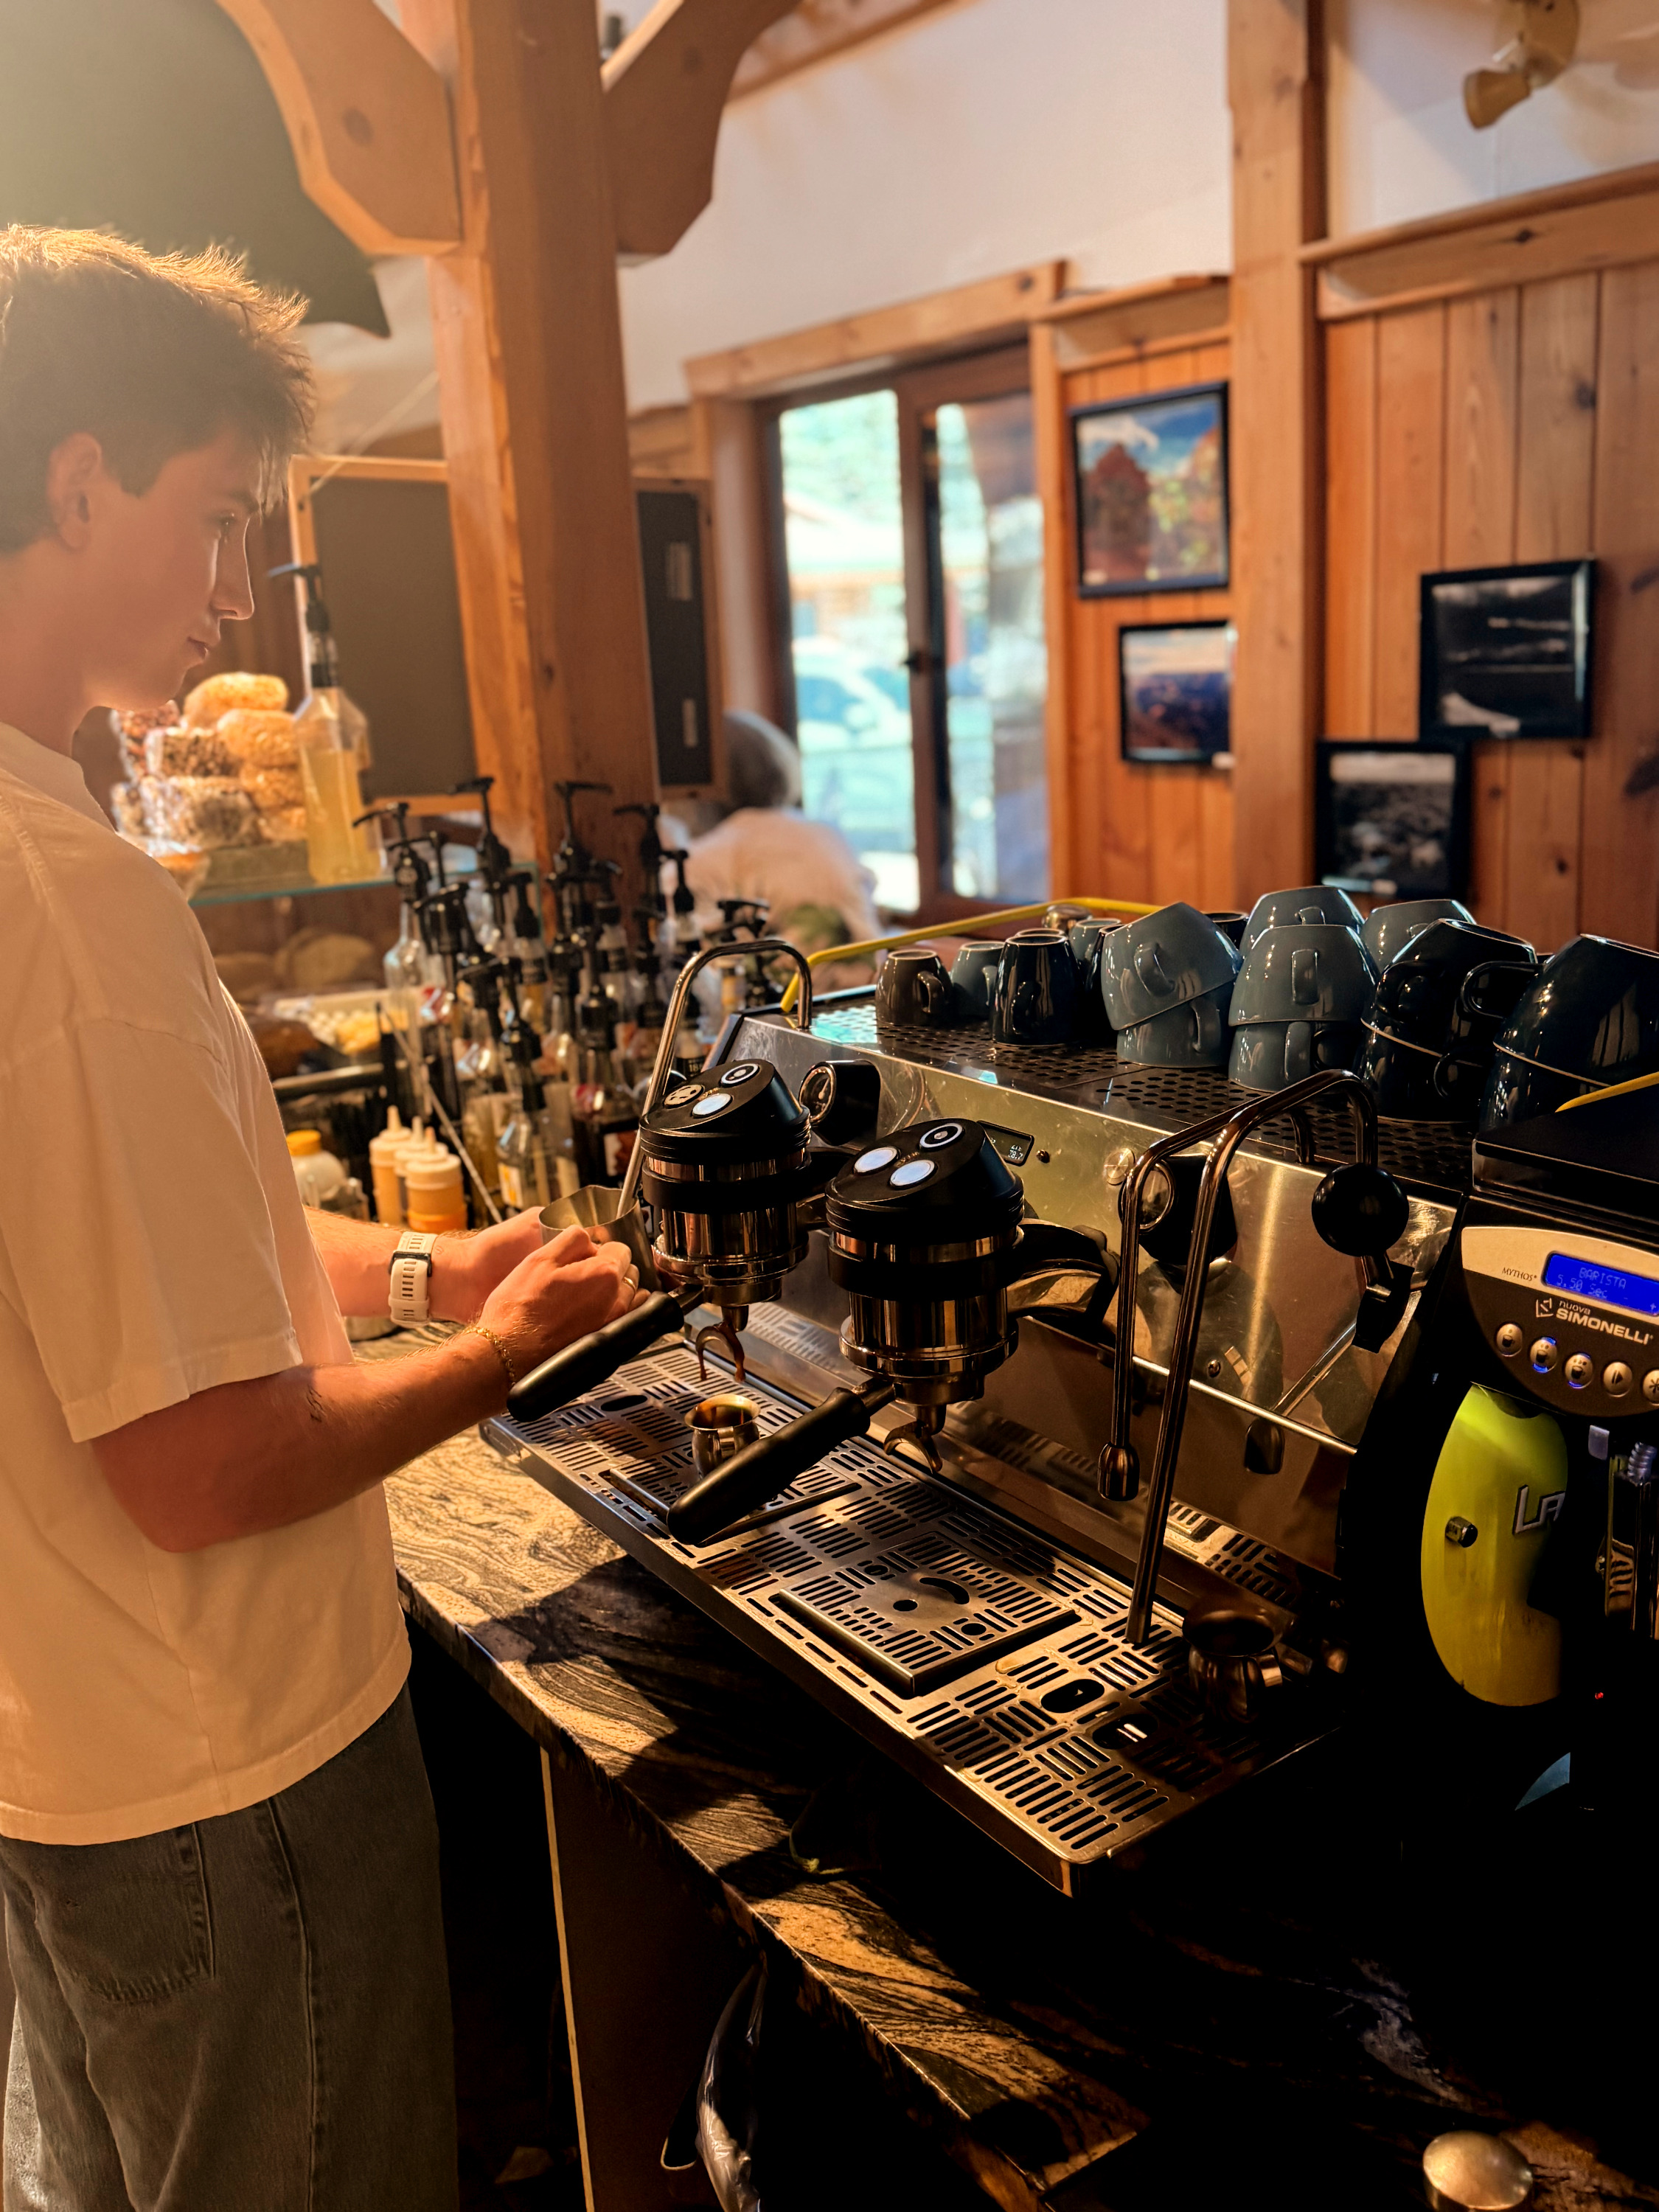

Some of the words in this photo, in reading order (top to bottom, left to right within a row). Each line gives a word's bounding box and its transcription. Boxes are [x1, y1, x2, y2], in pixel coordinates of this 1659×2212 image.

[1502, 1267, 1533, 1281] MYTHOS
[1579, 1267, 1627, 1290] BARISTA
[1559, 1300, 1591, 1315] nuova
[1556, 1307, 1650, 1345] SIMONELLI
